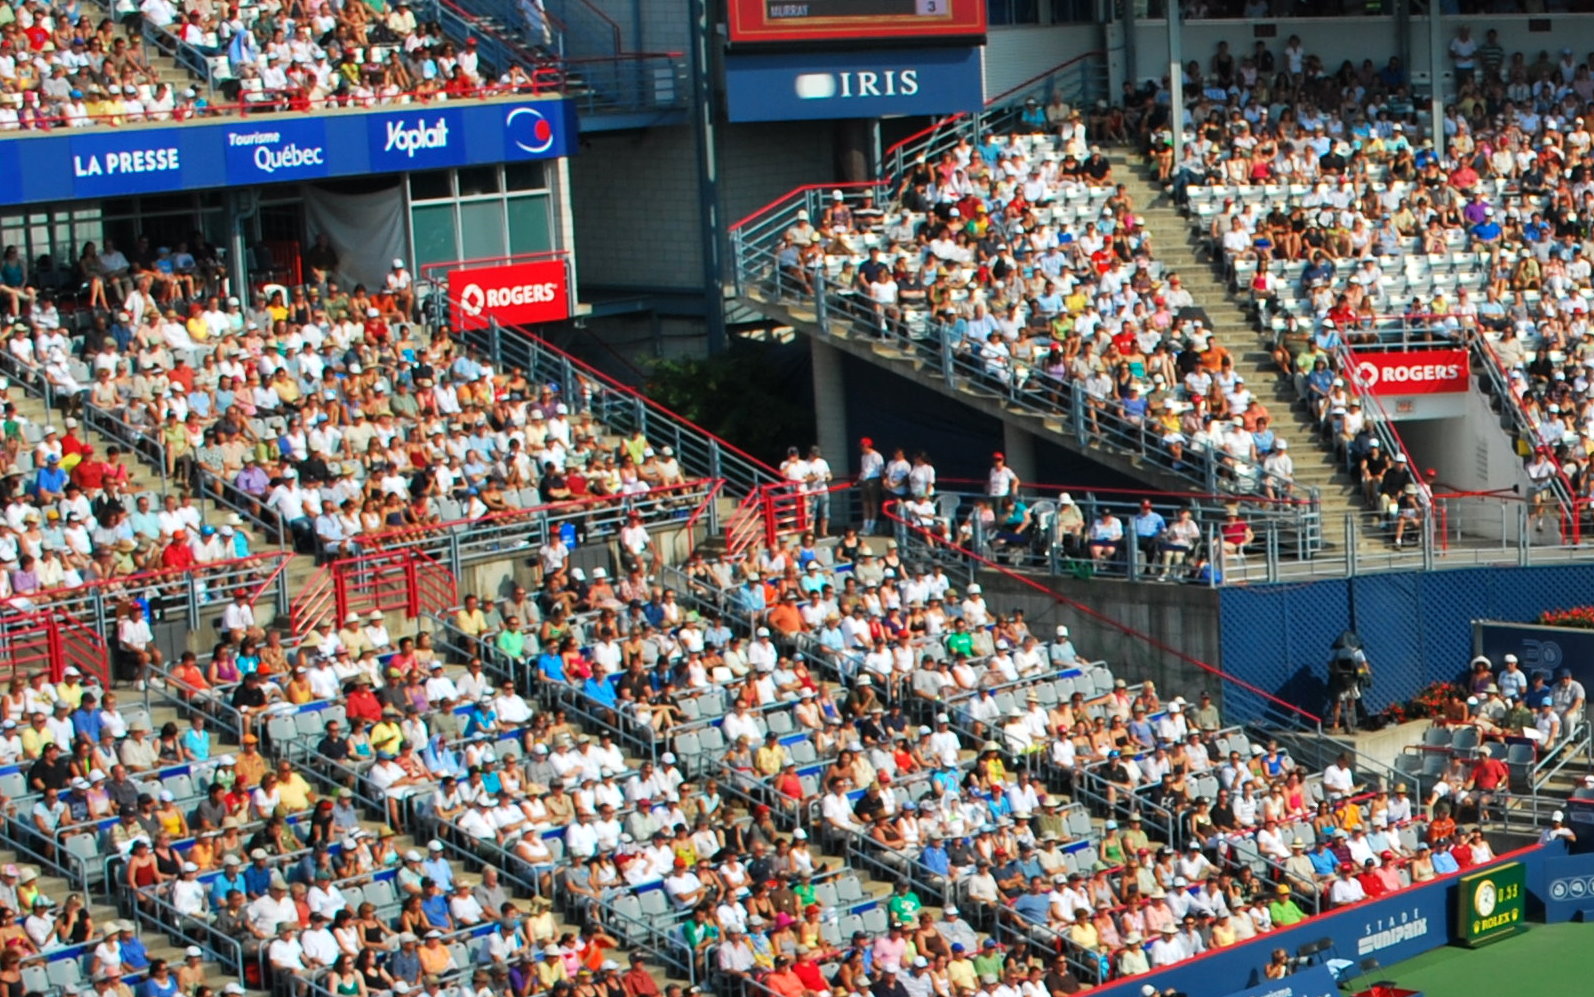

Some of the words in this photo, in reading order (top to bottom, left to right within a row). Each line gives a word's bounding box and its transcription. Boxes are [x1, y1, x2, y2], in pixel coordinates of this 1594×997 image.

[839, 70, 919, 97] IRIS
[228, 131, 280, 147] Tourisme
[384, 117, 449, 158] Yoplait
[74, 154, 103, 177] LA
[106, 147, 180, 175] PRESSE
[254, 144, 324, 172] Québec
[486, 282, 555, 308] ROGERS
[1381, 364, 1459, 383] ROGERS
[1365, 908, 1419, 936] STADE
[1482, 912, 1510, 931] ROLEX
